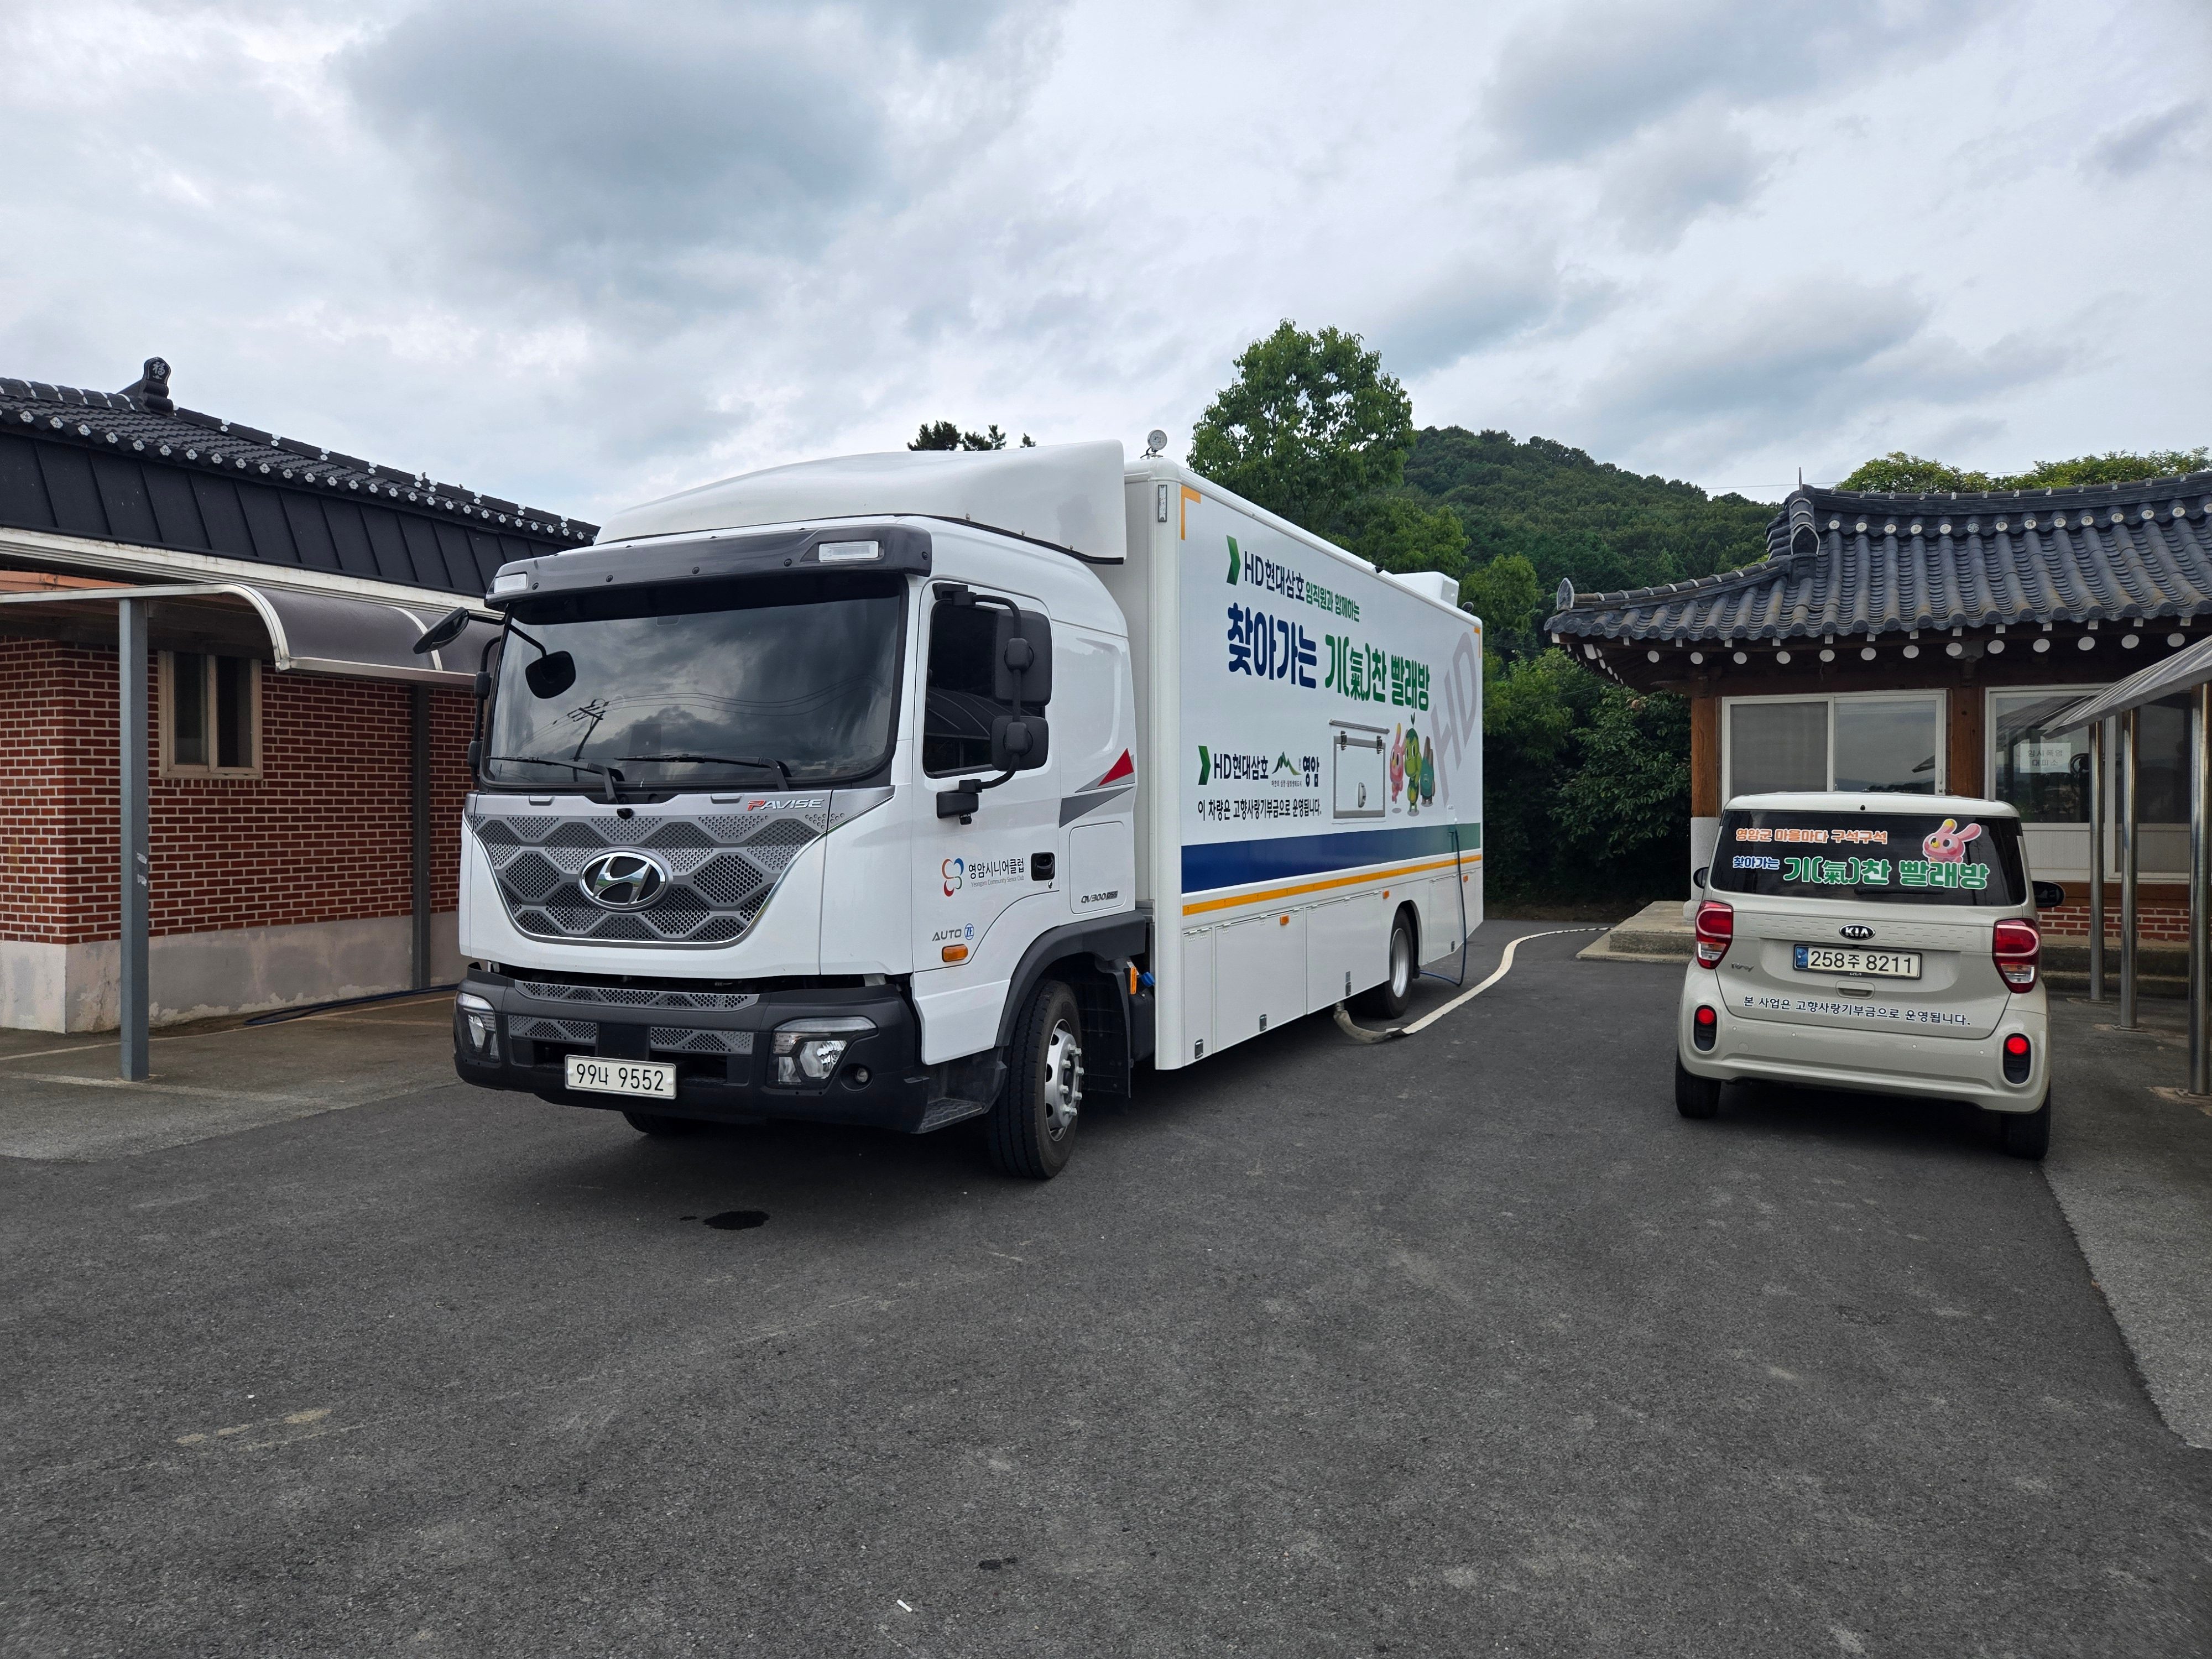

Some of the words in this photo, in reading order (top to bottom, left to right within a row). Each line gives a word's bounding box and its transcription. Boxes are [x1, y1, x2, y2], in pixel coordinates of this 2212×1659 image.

[1245, 551, 1305, 601] HD현대삼호
[1306, 581, 1333, 613] 임직원과
[1335, 593, 1360, 623] 함께하는
[1227, 602, 1317, 689] 찾아가는
[1325, 634, 1387, 703] 기(氣)찬
[1391, 654, 1430, 712] 빨래방
[1214, 753, 1269, 780] HD현대삼호
[1303, 756, 1319, 787] 영암
[747, 799, 825, 811] PAVISE
[1198, 800, 1205, 821] 이
[1208, 799, 1230, 821] 차량은
[1233, 799, 1291, 821] 고향사랑기부금으로
[1292, 798, 1322, 818] 운영됩니다.
[1736, 828, 1772, 842] 영암군
[1775, 829, 1829, 843] 마을마다
[1831, 830, 1888, 844] 구석구석
[968, 858, 1024, 879] 영암시니어클럽
[1733, 855, 1780, 870] 찾아가는
[1783, 856, 1892, 885] 기(氣)찬
[1899, 859, 1990, 890] 빨래방
[932, 928, 962, 941] AUTO
[1845, 927, 1869, 937] KIA
[1811, 951, 1860, 969] 258주
[1866, 954, 1912, 973] 8211
[1744, 997, 1754, 1007] 본
[1758, 998, 1791, 1010] 사업은
[1796, 1001, 1900, 1019] 고향사랑기부금으로
[1905, 1010, 1971, 1026] 운영됩니다.
[577, 1063, 608, 1085] 99나
[618, 1067, 664, 1091] 9552
